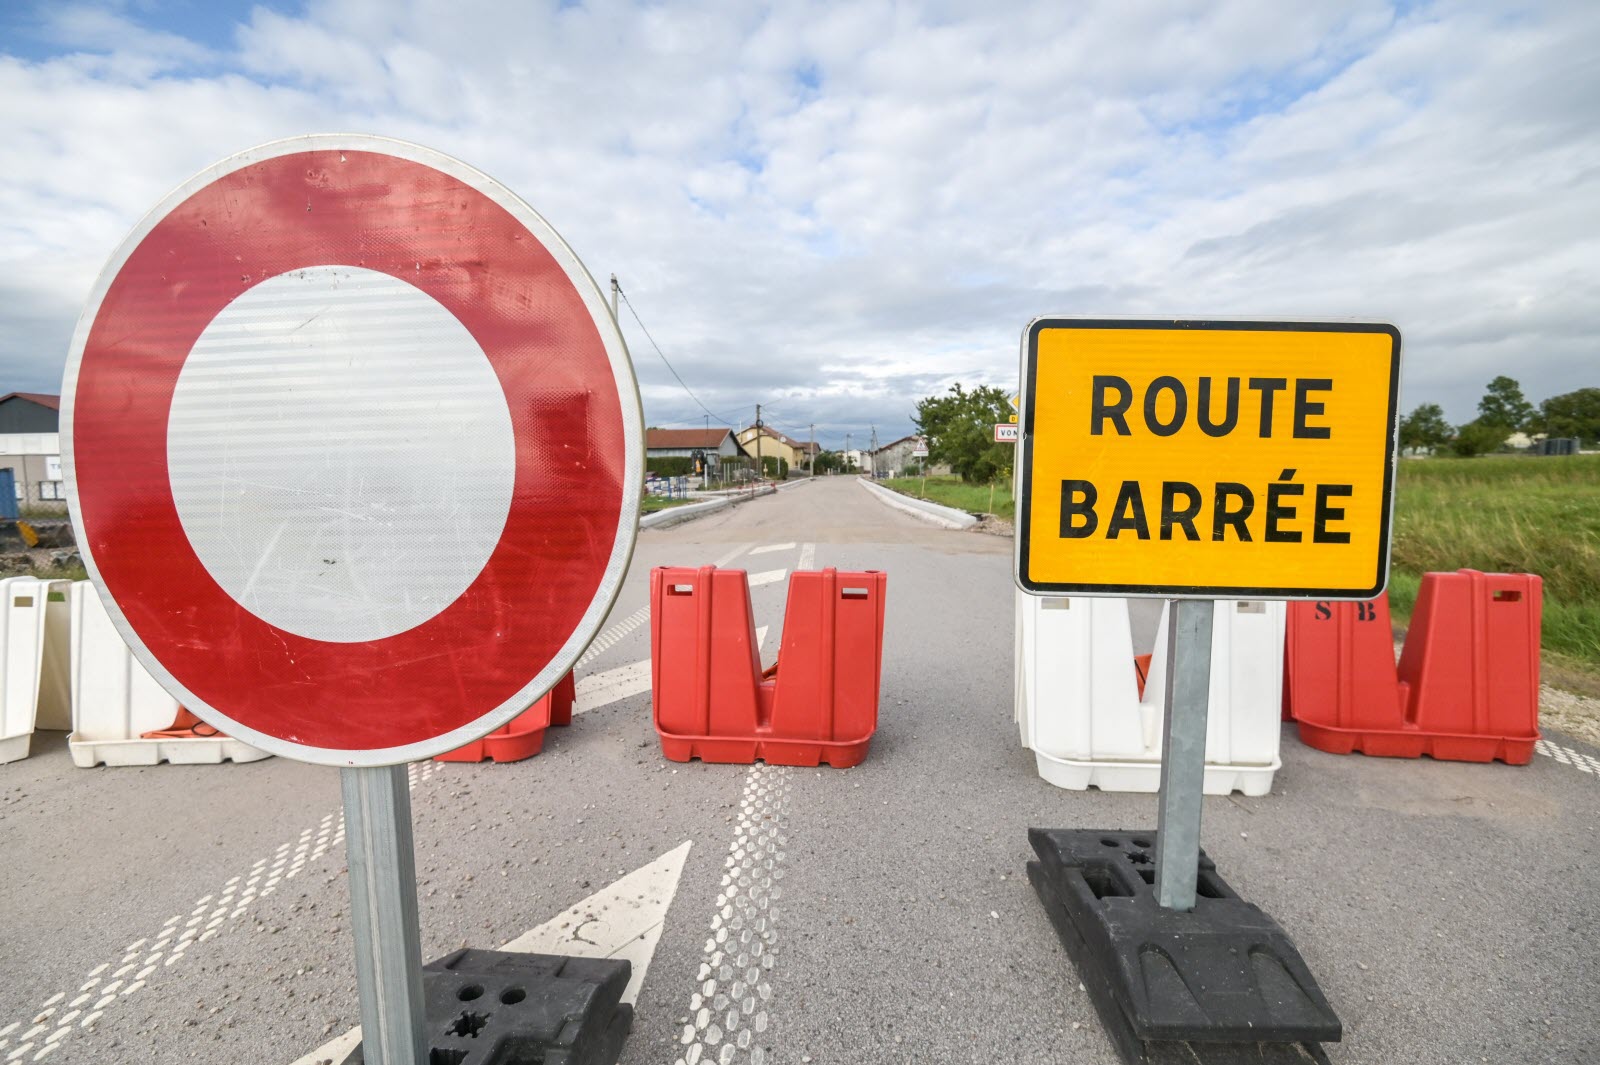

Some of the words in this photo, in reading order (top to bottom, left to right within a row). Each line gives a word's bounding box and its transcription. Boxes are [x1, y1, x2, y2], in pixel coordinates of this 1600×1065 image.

[1090, 375, 1333, 439] ROUTE
[1059, 469, 1353, 544] BARRÉE
[1315, 601, 1332, 620] S
[1357, 601, 1376, 621] B
